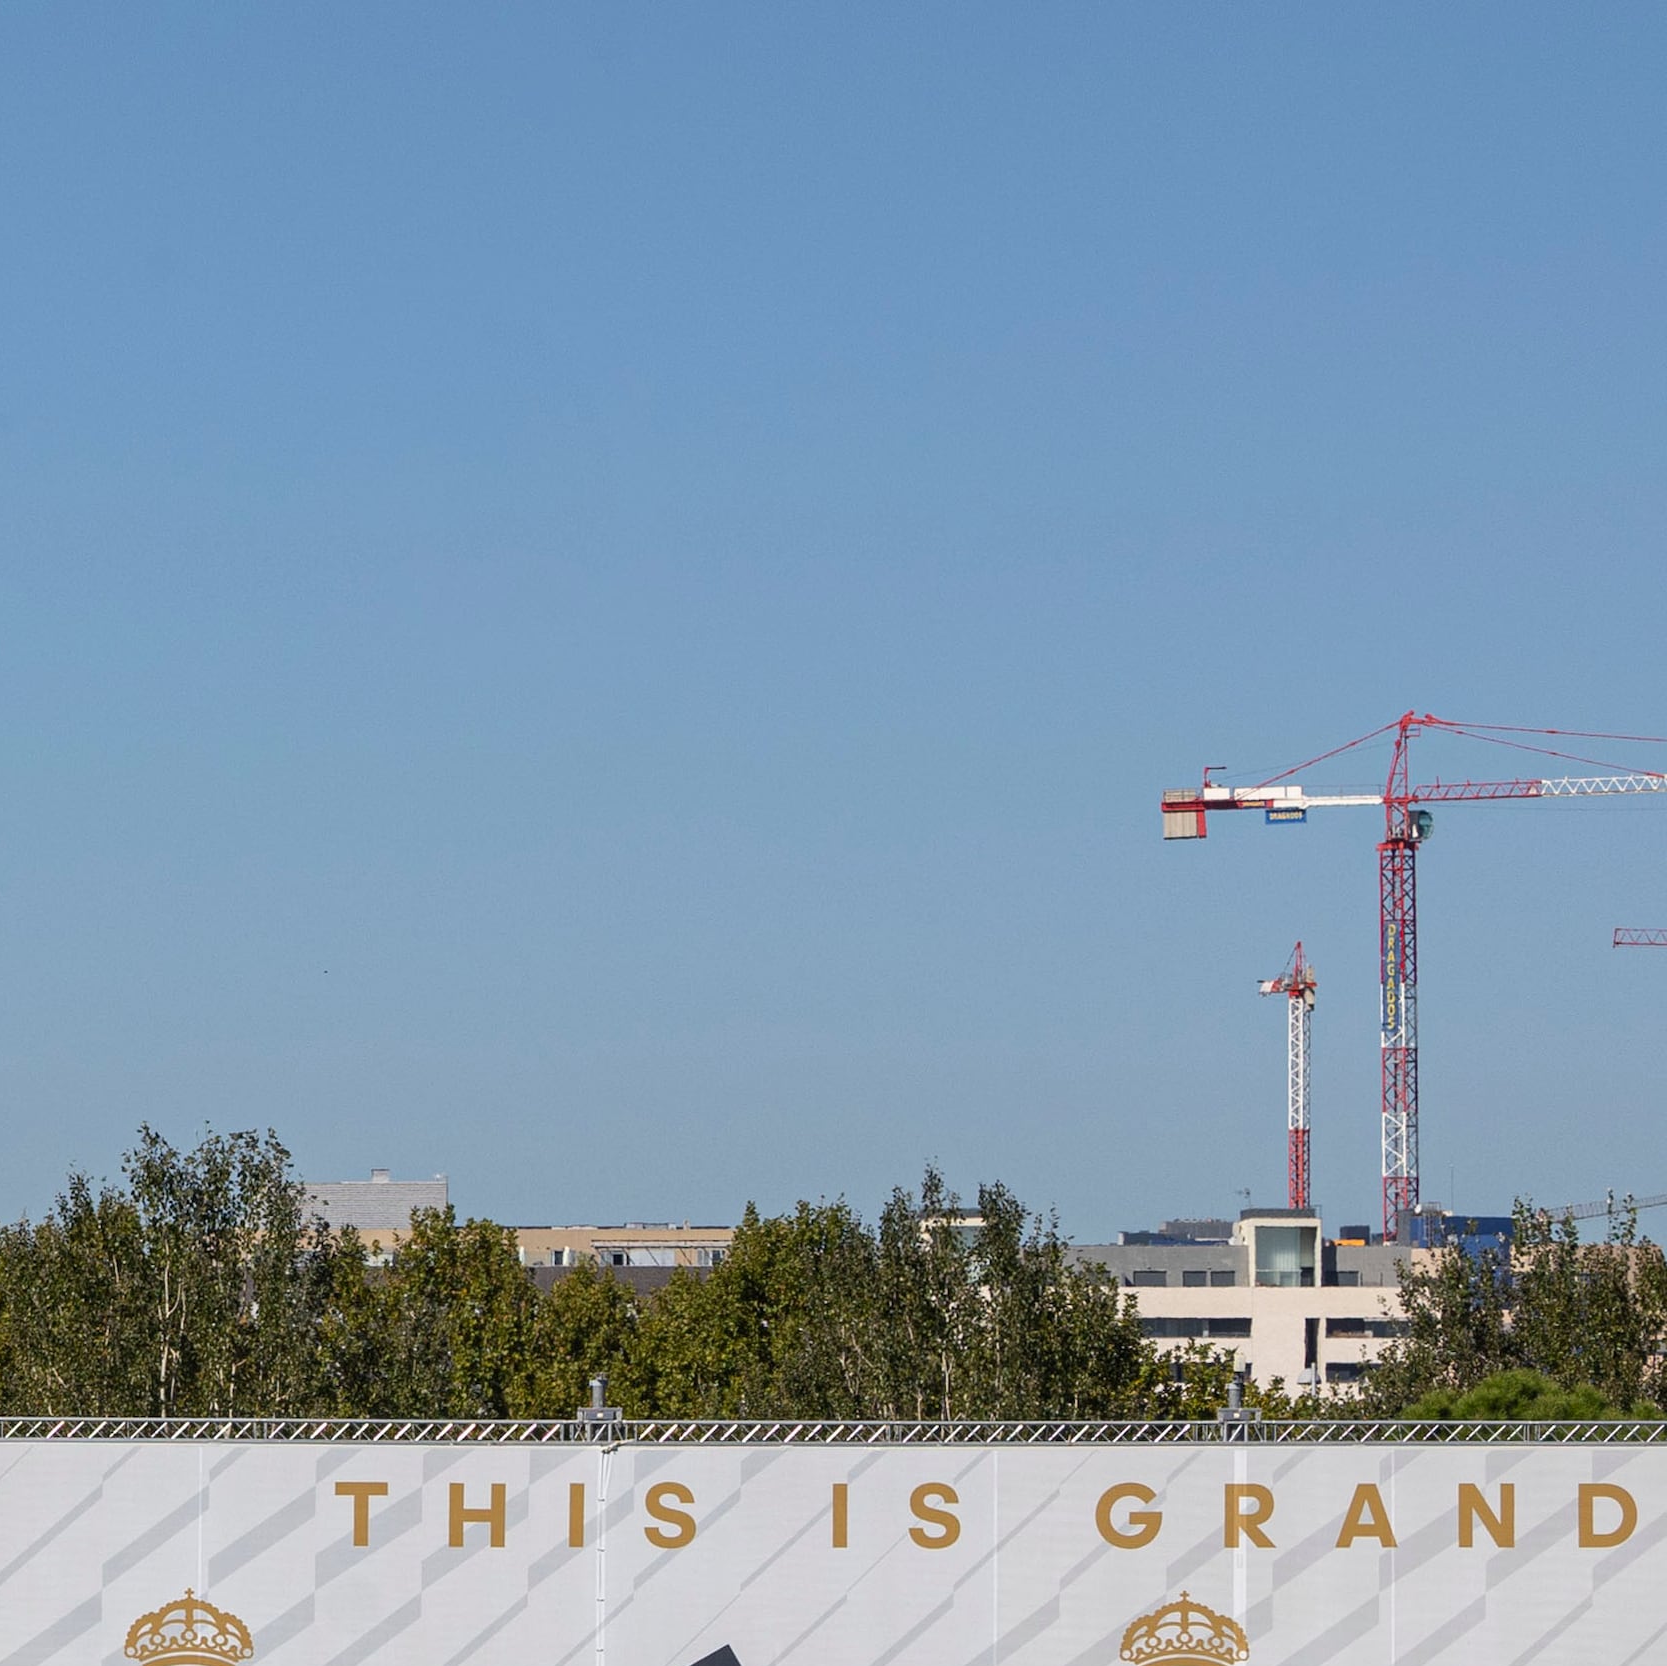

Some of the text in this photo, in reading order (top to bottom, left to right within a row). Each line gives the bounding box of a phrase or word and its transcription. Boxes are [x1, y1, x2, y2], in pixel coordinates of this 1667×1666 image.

[1386, 923, 1397, 1030] DRAGADOS
[335, 1482, 1637, 1549] THIS IS GRAND
